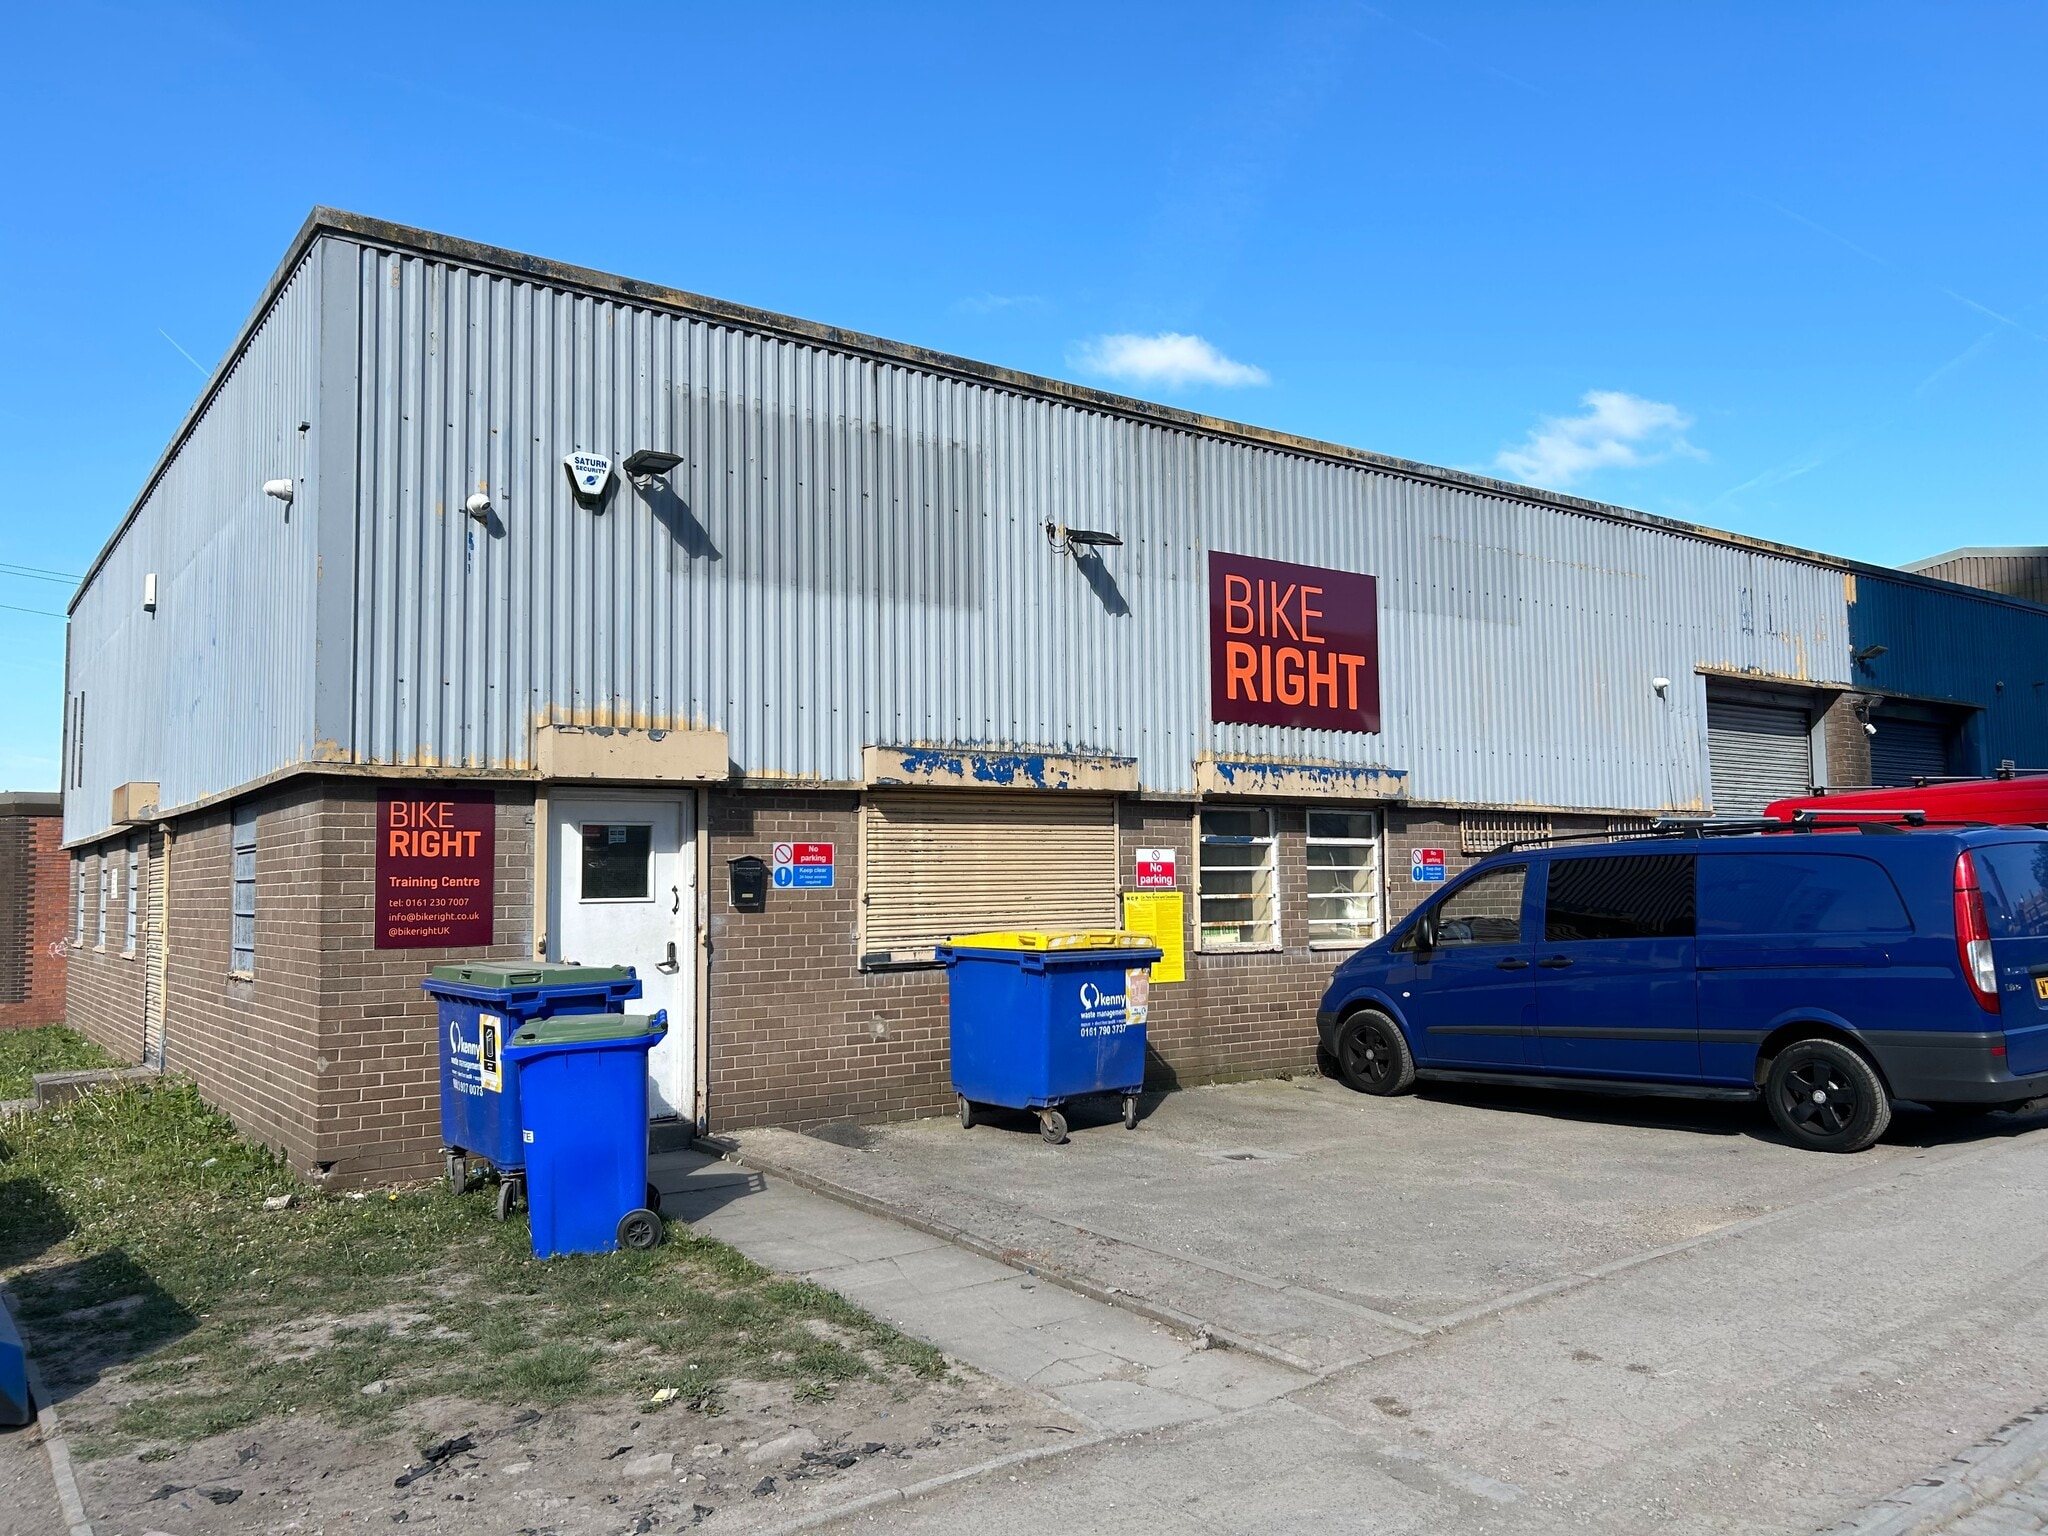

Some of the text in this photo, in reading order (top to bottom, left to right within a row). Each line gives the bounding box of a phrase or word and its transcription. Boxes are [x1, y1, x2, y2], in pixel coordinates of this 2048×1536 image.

[575, 456, 607, 468] SATURN
[575, 465, 606, 474] SECURITY
[1225, 574, 1325, 644] BIKE
[1226, 640, 1366, 710] RIGHT
[390, 801, 455, 828] BIKE
[389, 830, 482, 857] RIGHT
[801, 855, 826, 863] parking
[1150, 862, 1163, 873] No
[389, 876, 480, 889] Training Centre
[1140, 874, 1173, 886] parking
[389, 897, 470, 907] tel: 0161 230 7007
[388, 911, 480, 923] info@bikeright.co.uk
[388, 926, 451, 938] @bikerightUK
[1100, 992, 1126, 1008] kenny
[1080, 1010, 1096, 1019] waste
[1097, 1008, 1127, 1019] management
[1080, 1026, 1097, 1038] 0161
[1099, 1024, 1111, 1036] 790
[1112, 1023, 1127, 1034] 3737
[461, 1036, 480, 1060] kenny
